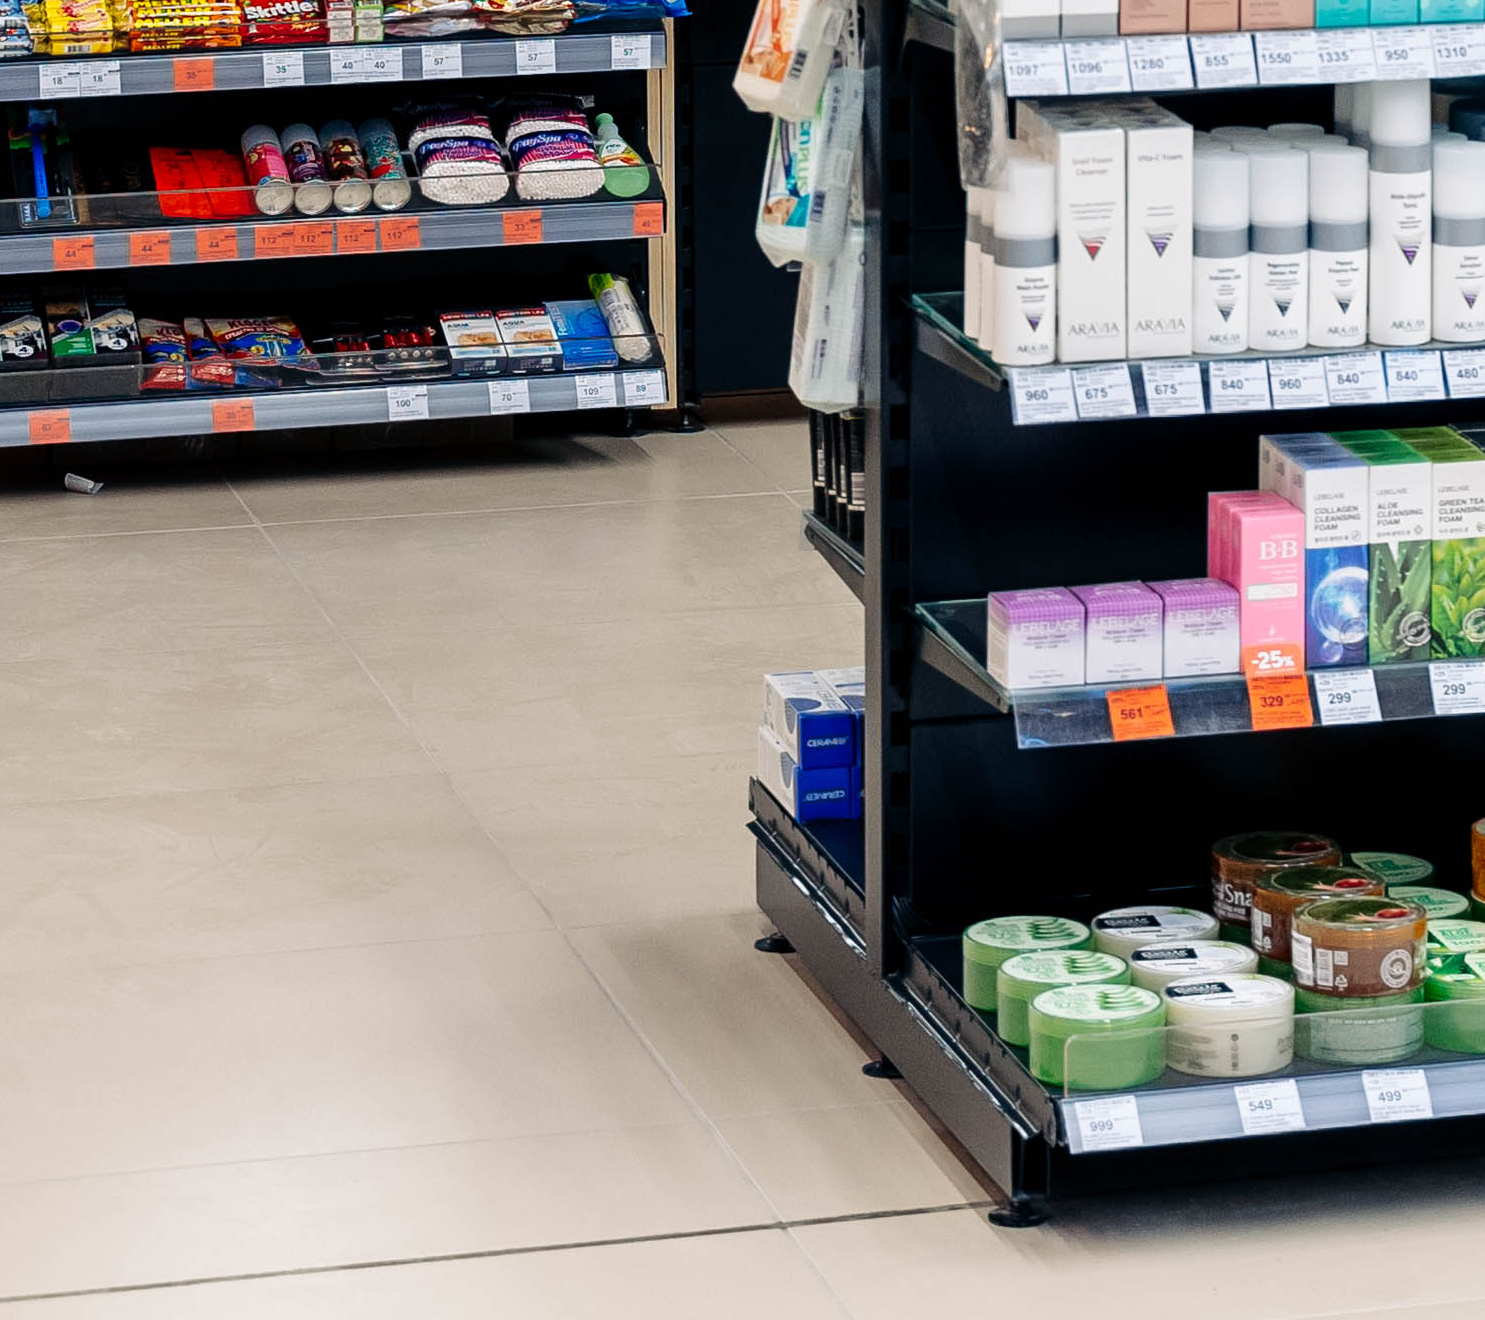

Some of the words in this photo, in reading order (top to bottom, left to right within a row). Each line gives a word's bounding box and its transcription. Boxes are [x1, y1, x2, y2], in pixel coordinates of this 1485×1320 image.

[1439, 499, 1465, 507] GREEN
[1315, 506, 1358, 516] COLLAGEN
[1377, 508, 1424, 519] CLEANSING
[1439, 506, 1485, 516] CLEANSING
[1315, 514, 1361, 523] CLEANSING
[1377, 519, 1401, 527] FOAM
[1439, 516, 1462, 524] FOAM
[1315, 523, 1338, 531] FOAM
[1251, 651, 1295, 670] -25%
